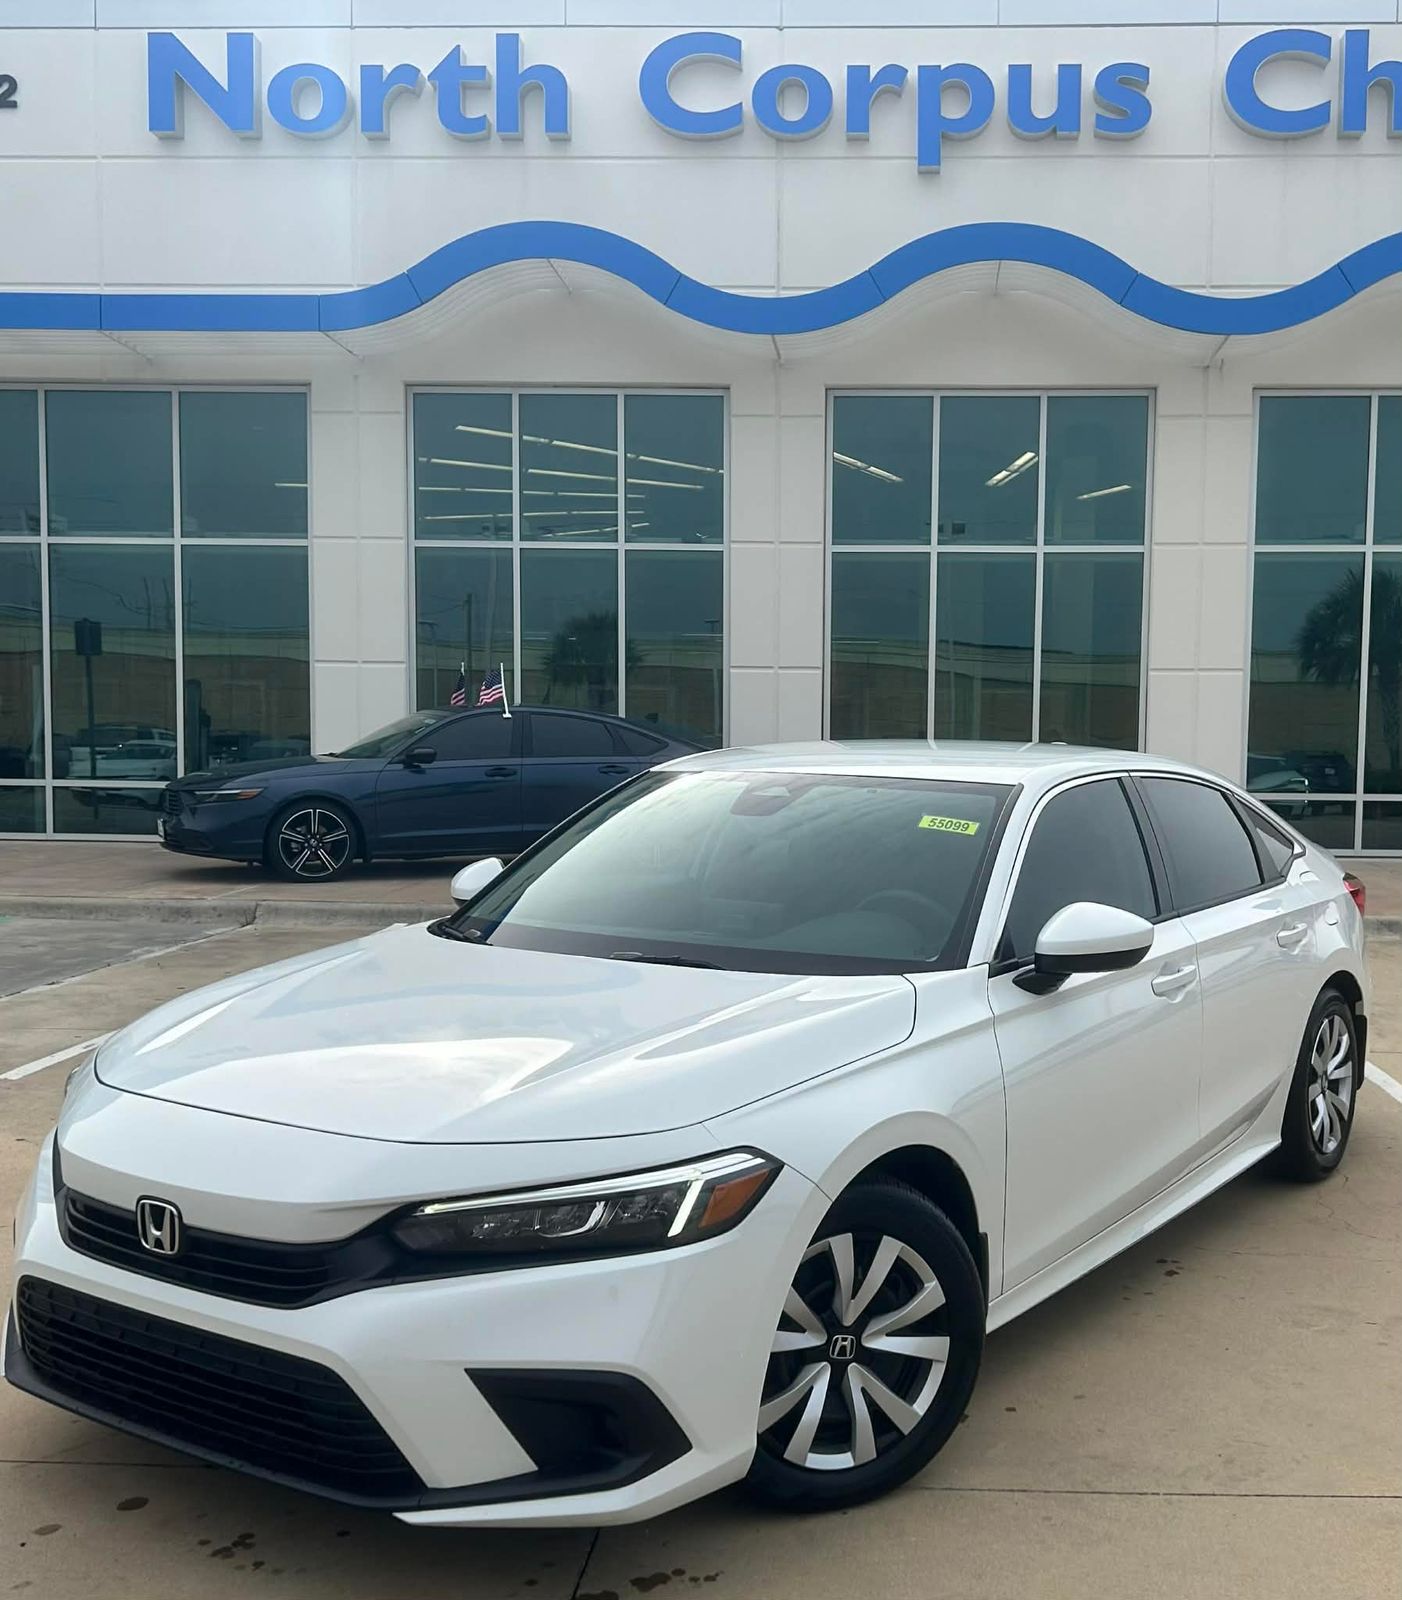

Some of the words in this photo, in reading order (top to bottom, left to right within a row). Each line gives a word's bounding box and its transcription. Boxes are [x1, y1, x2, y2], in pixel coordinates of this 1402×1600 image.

[147, 32, 570, 138] North
[638, 31, 1152, 170] Corpus
[1224, 29, 1402, 135] Ch
[927, 817, 970, 832] 55099
